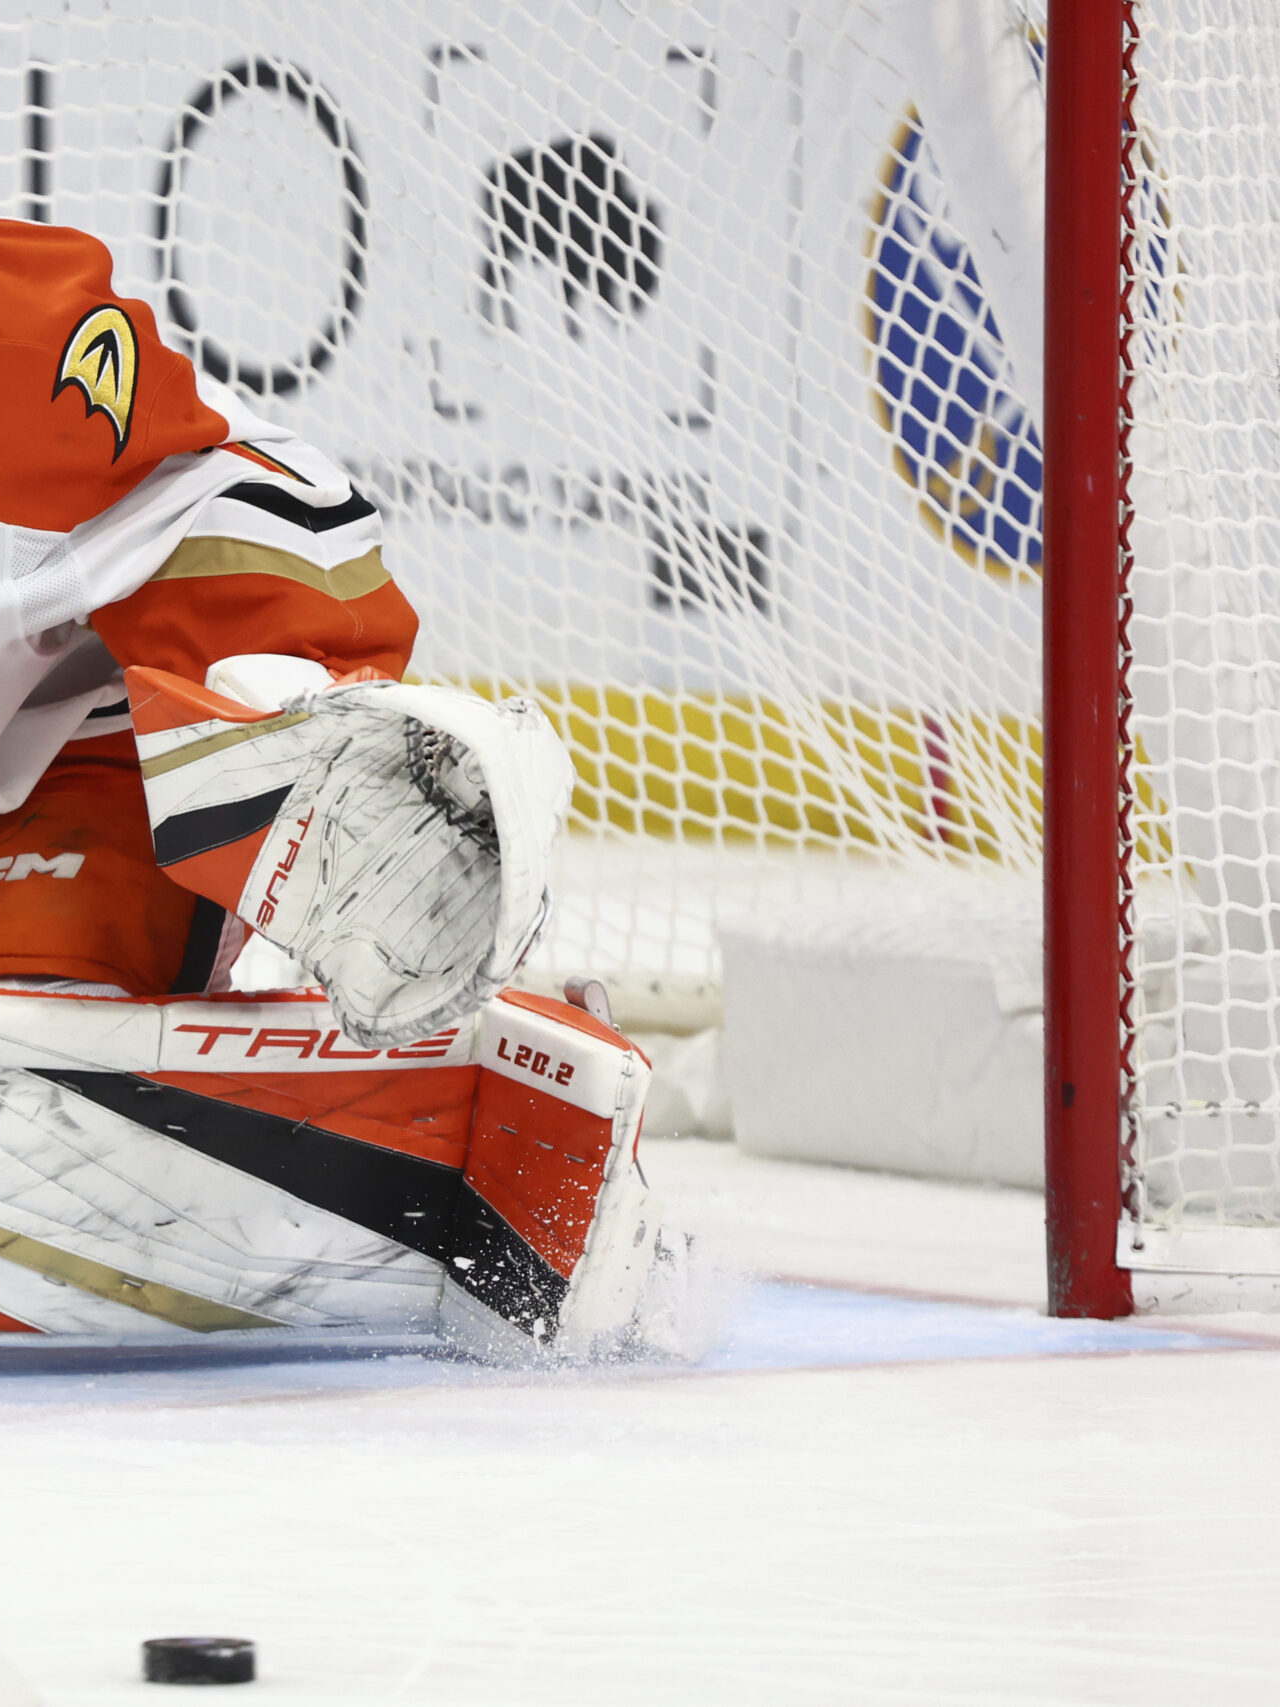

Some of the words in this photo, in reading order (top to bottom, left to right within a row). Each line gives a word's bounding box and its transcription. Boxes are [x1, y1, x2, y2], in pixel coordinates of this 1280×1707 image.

[255, 805, 315, 929] TRUE
[172, 1023, 460, 1060] TRUE
[496, 1036, 576, 1087] L20.2
